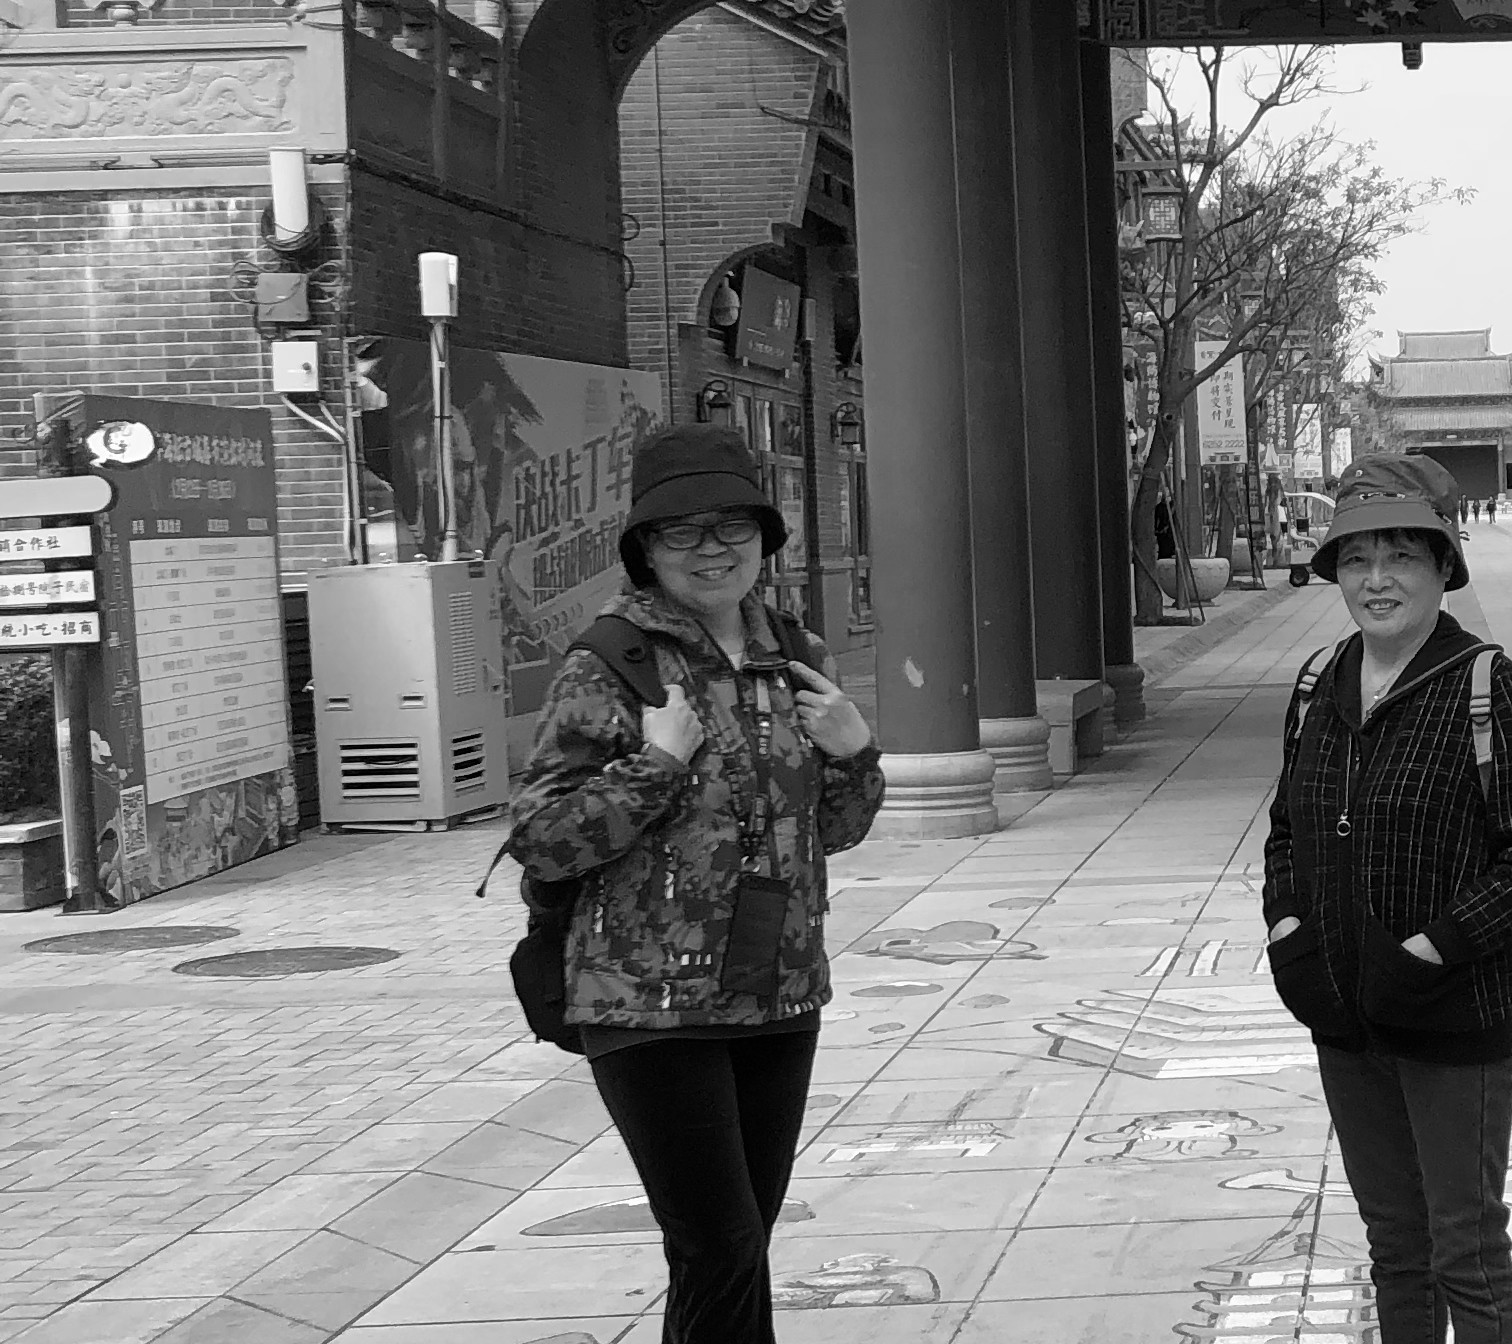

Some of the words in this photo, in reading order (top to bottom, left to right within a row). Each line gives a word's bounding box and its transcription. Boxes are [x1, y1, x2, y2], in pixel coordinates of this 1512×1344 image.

[1209, 374, 1222, 423] 即将交付
[1222, 363, 1236, 430] 一期实景呈现
